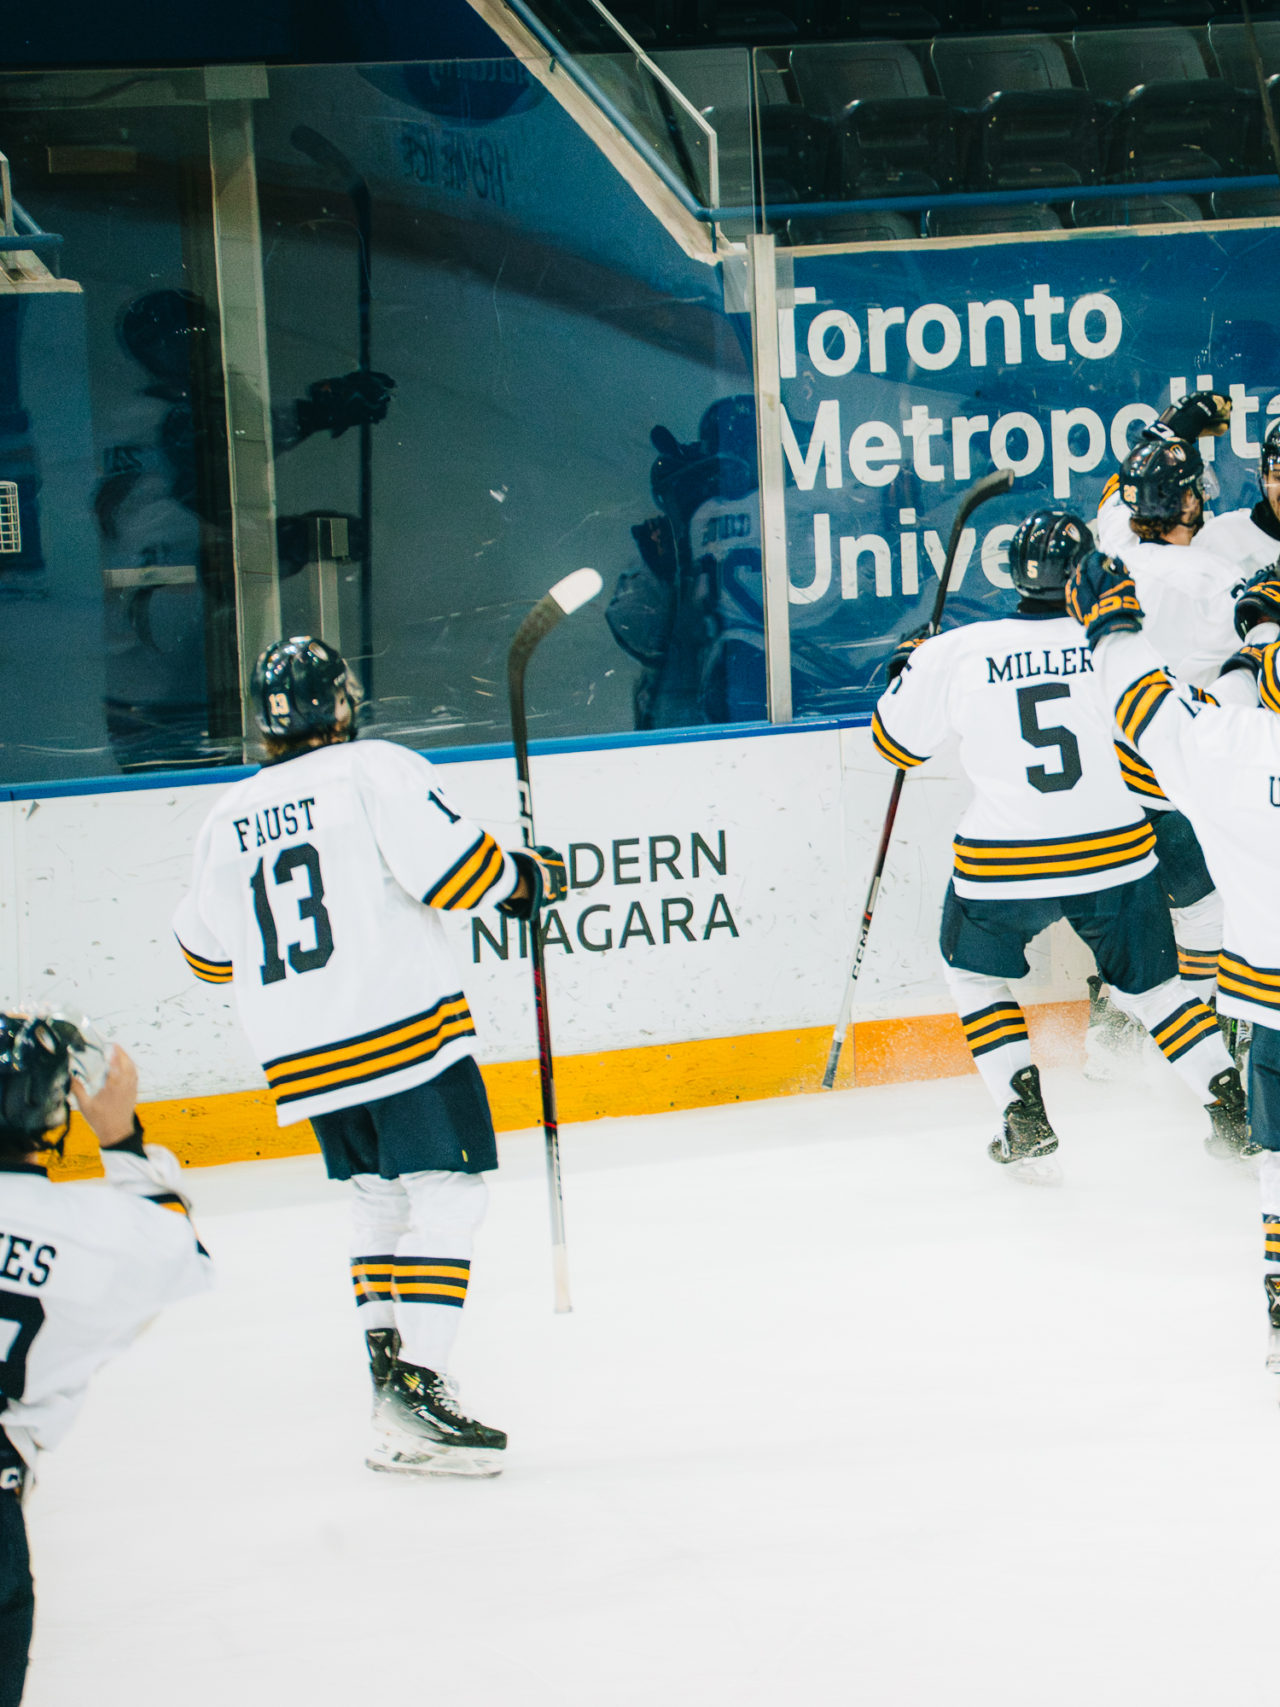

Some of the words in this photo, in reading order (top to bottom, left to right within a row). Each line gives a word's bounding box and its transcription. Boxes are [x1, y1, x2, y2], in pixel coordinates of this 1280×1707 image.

[778, 284, 1122, 379] Toronto
[1026, 559, 1039, 579] 5
[986, 646, 1095, 684] MILLER
[1016, 682, 1083, 794] 5
[232, 798, 316, 852] FAUST
[569, 830, 728, 889] DERN
[250, 843, 335, 985] 13
[471, 893, 740, 963] NIAGARA
[0, 1233, 58, 1288] ES
